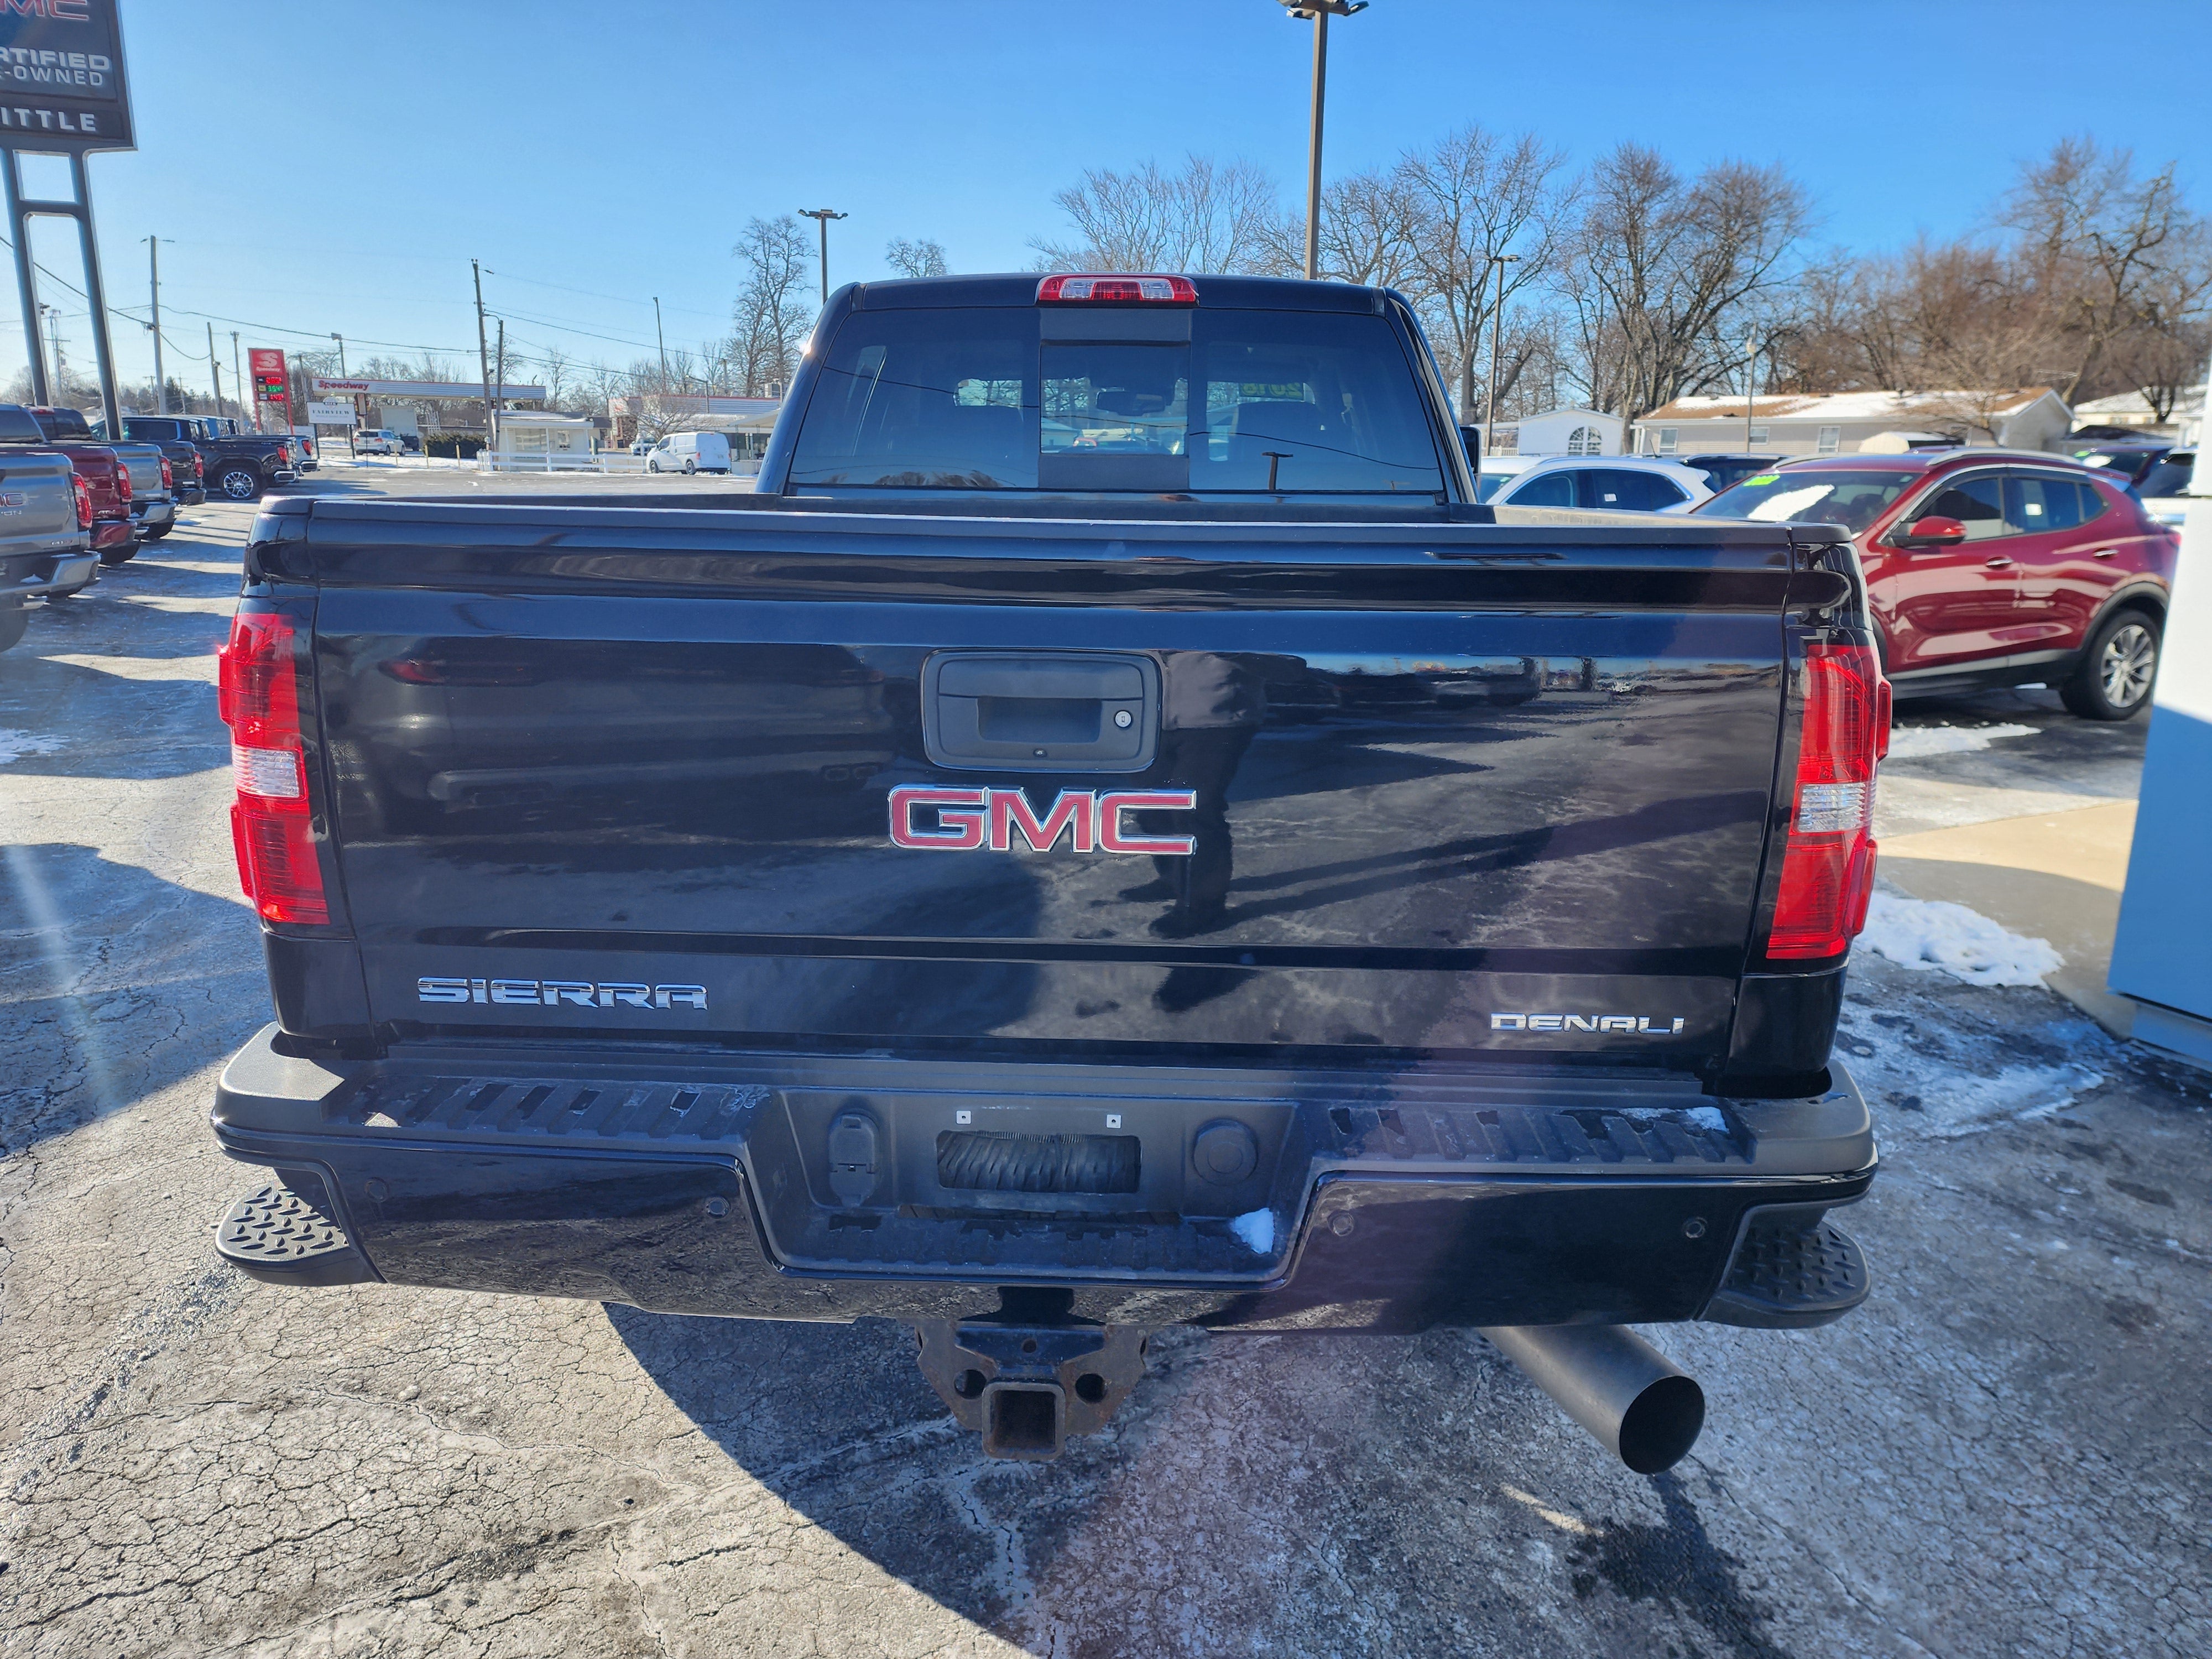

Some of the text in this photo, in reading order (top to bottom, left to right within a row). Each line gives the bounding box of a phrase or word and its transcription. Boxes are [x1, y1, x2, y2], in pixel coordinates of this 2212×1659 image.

[317, 379, 369, 391] Speedway
[888, 783, 1197, 855] GMC
[418, 976, 708, 1010] SIERRA
[1490, 1013, 1684, 1035] DENALI
